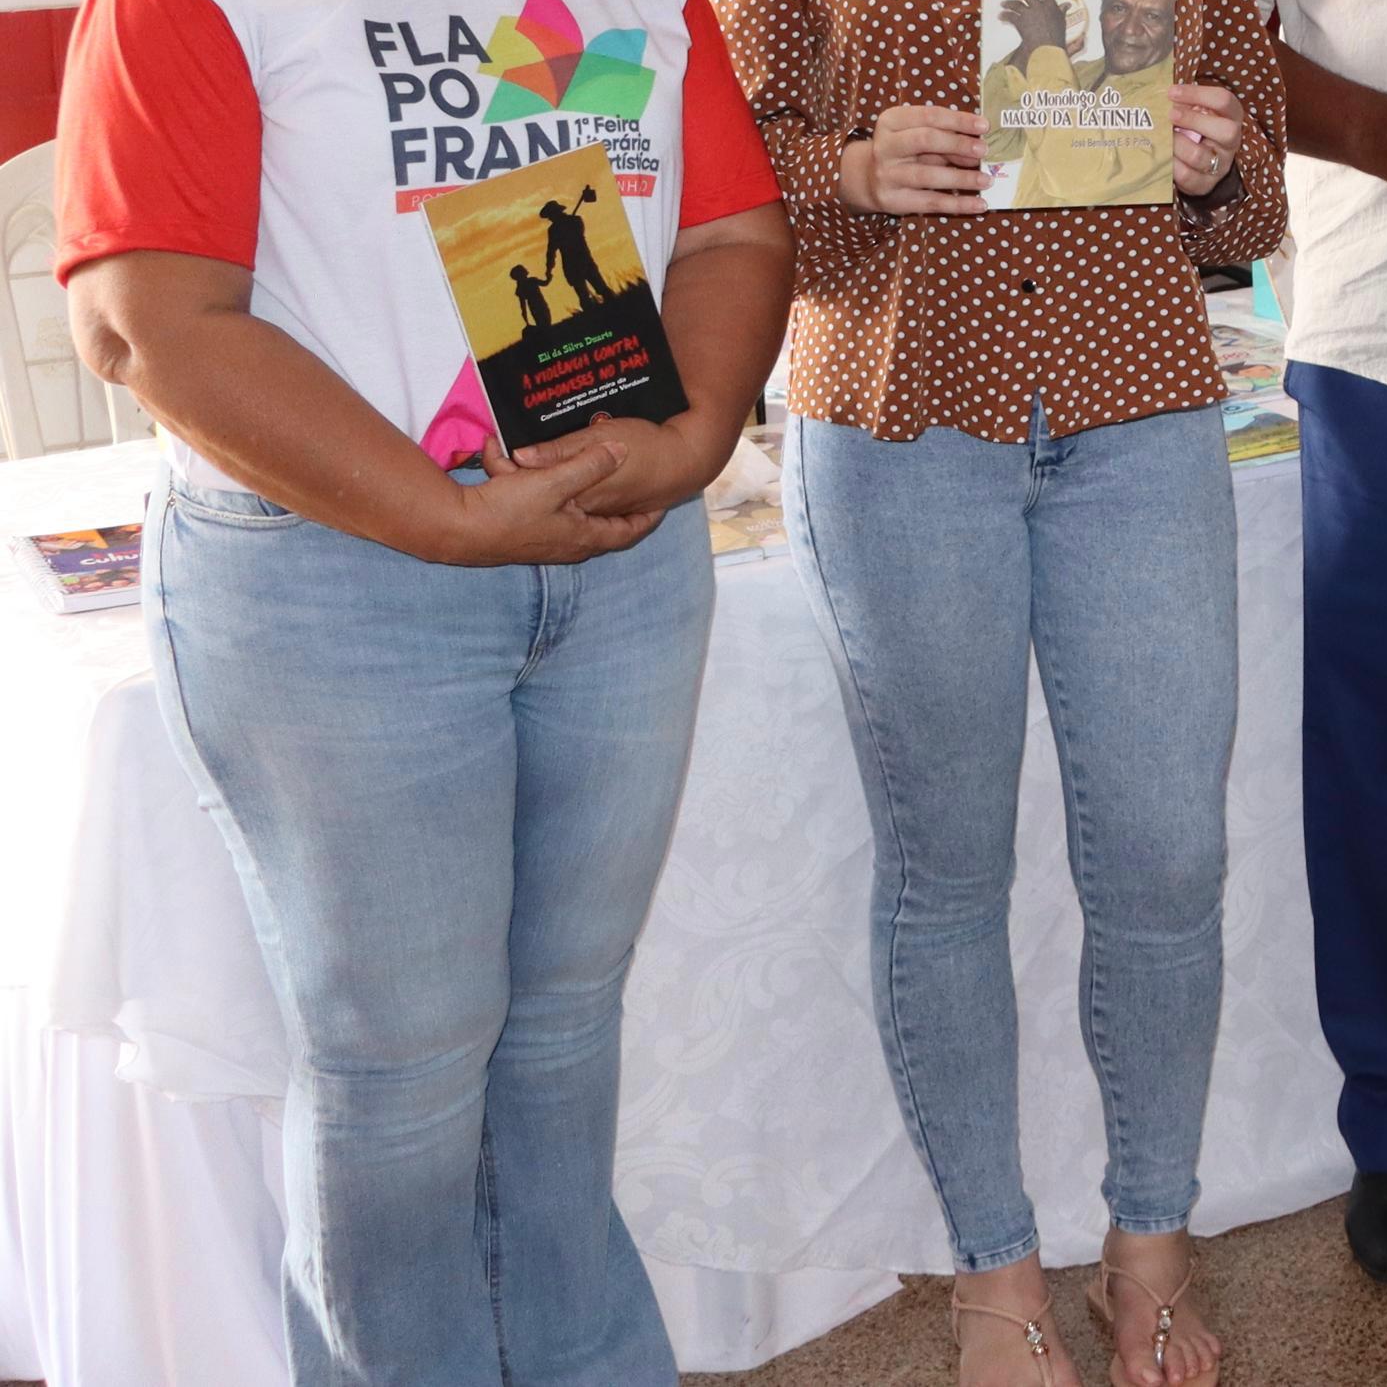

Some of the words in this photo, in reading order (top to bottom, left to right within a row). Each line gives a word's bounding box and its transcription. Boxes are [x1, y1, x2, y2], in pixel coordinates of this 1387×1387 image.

[364, 15, 493, 67] FLA
[379, 68, 480, 122] PO
[1036, 89, 1095, 110] Monólogo
[1102, 87, 1119, 106] do
[594, 114, 639, 133] Feira
[1003, 111, 1047, 126] MAURO
[1053, 111, 1071, 126] DA
[1079, 109, 1152, 127] LATINHA
[391, 120, 570, 186] FRAN
[609, 152, 660, 171] rtística
[593, 335, 640, 363] CONTRA
[599, 364, 616, 380] NO
